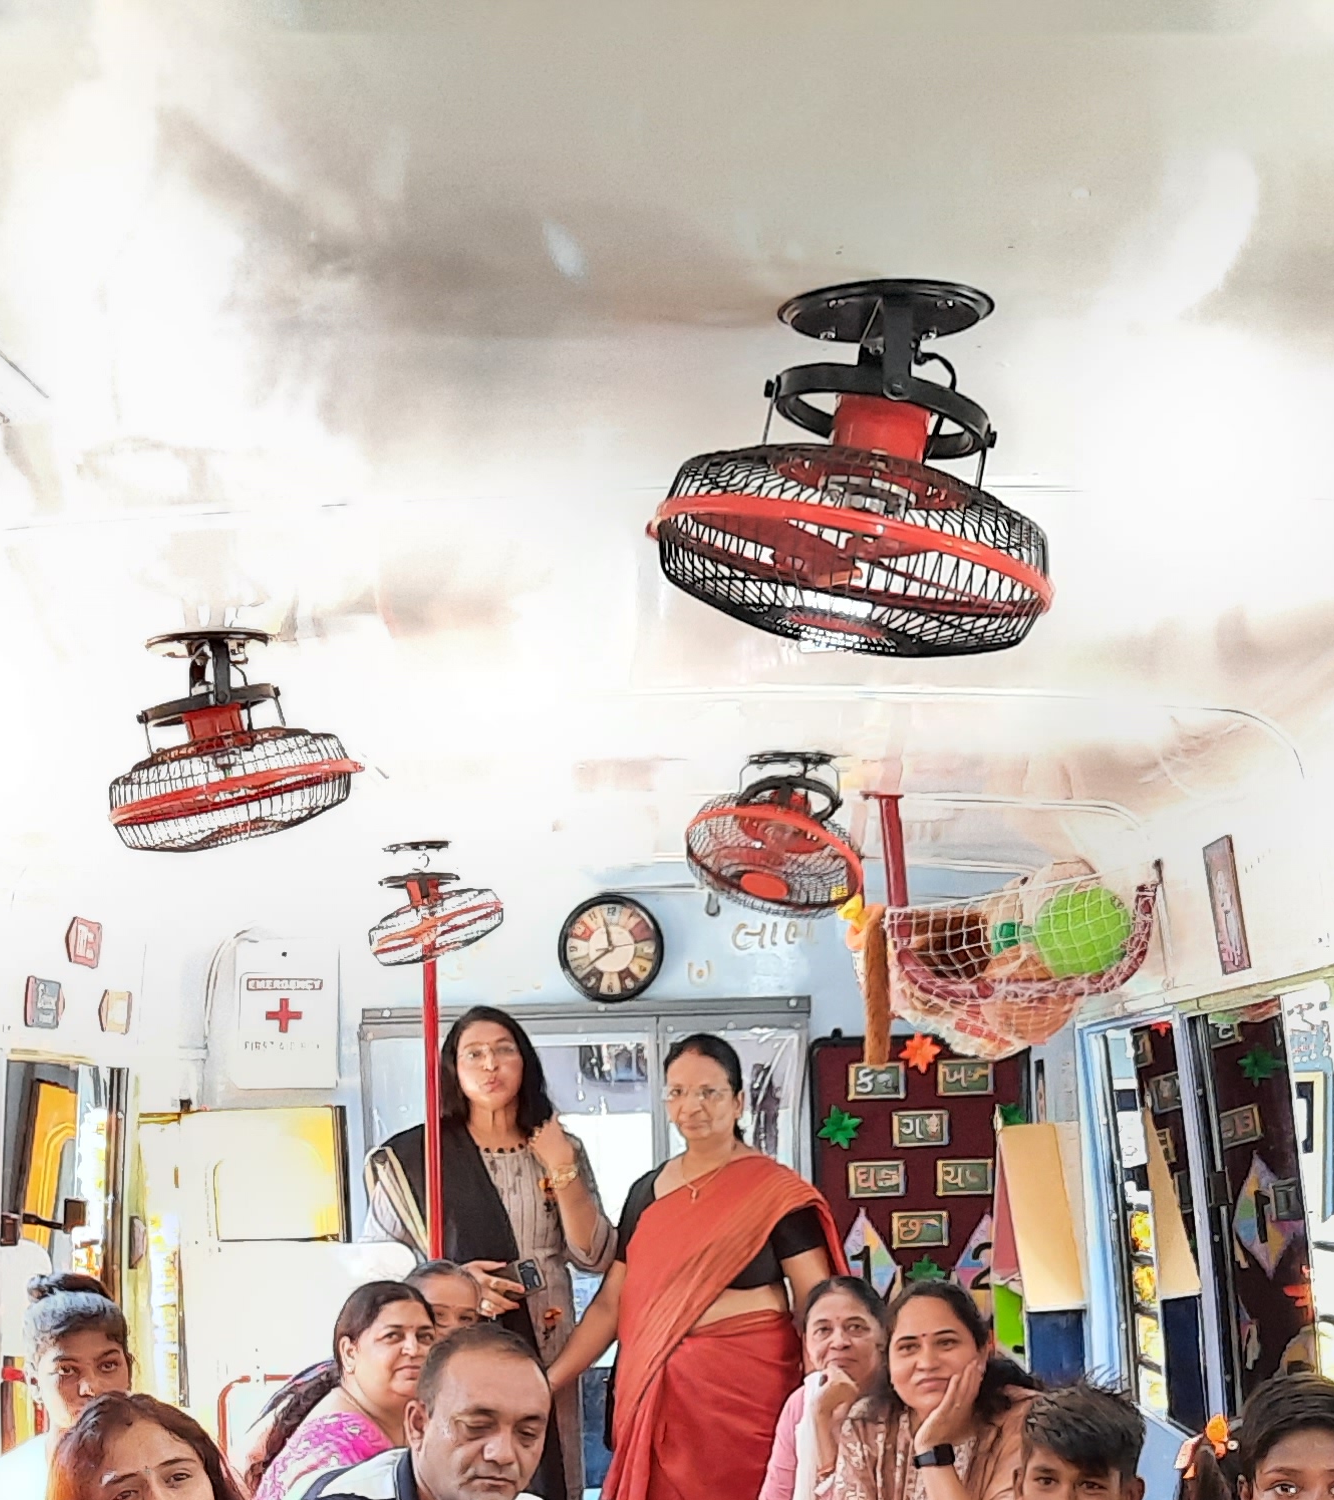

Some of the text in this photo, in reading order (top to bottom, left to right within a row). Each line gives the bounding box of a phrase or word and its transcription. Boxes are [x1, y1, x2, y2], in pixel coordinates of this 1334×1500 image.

[248, 979, 322, 990] EMERGENCY
[900, 1117, 924, 1140] ગ
[850, 1245, 872, 1288] 1
[970, 1242, 992, 1290] 2
